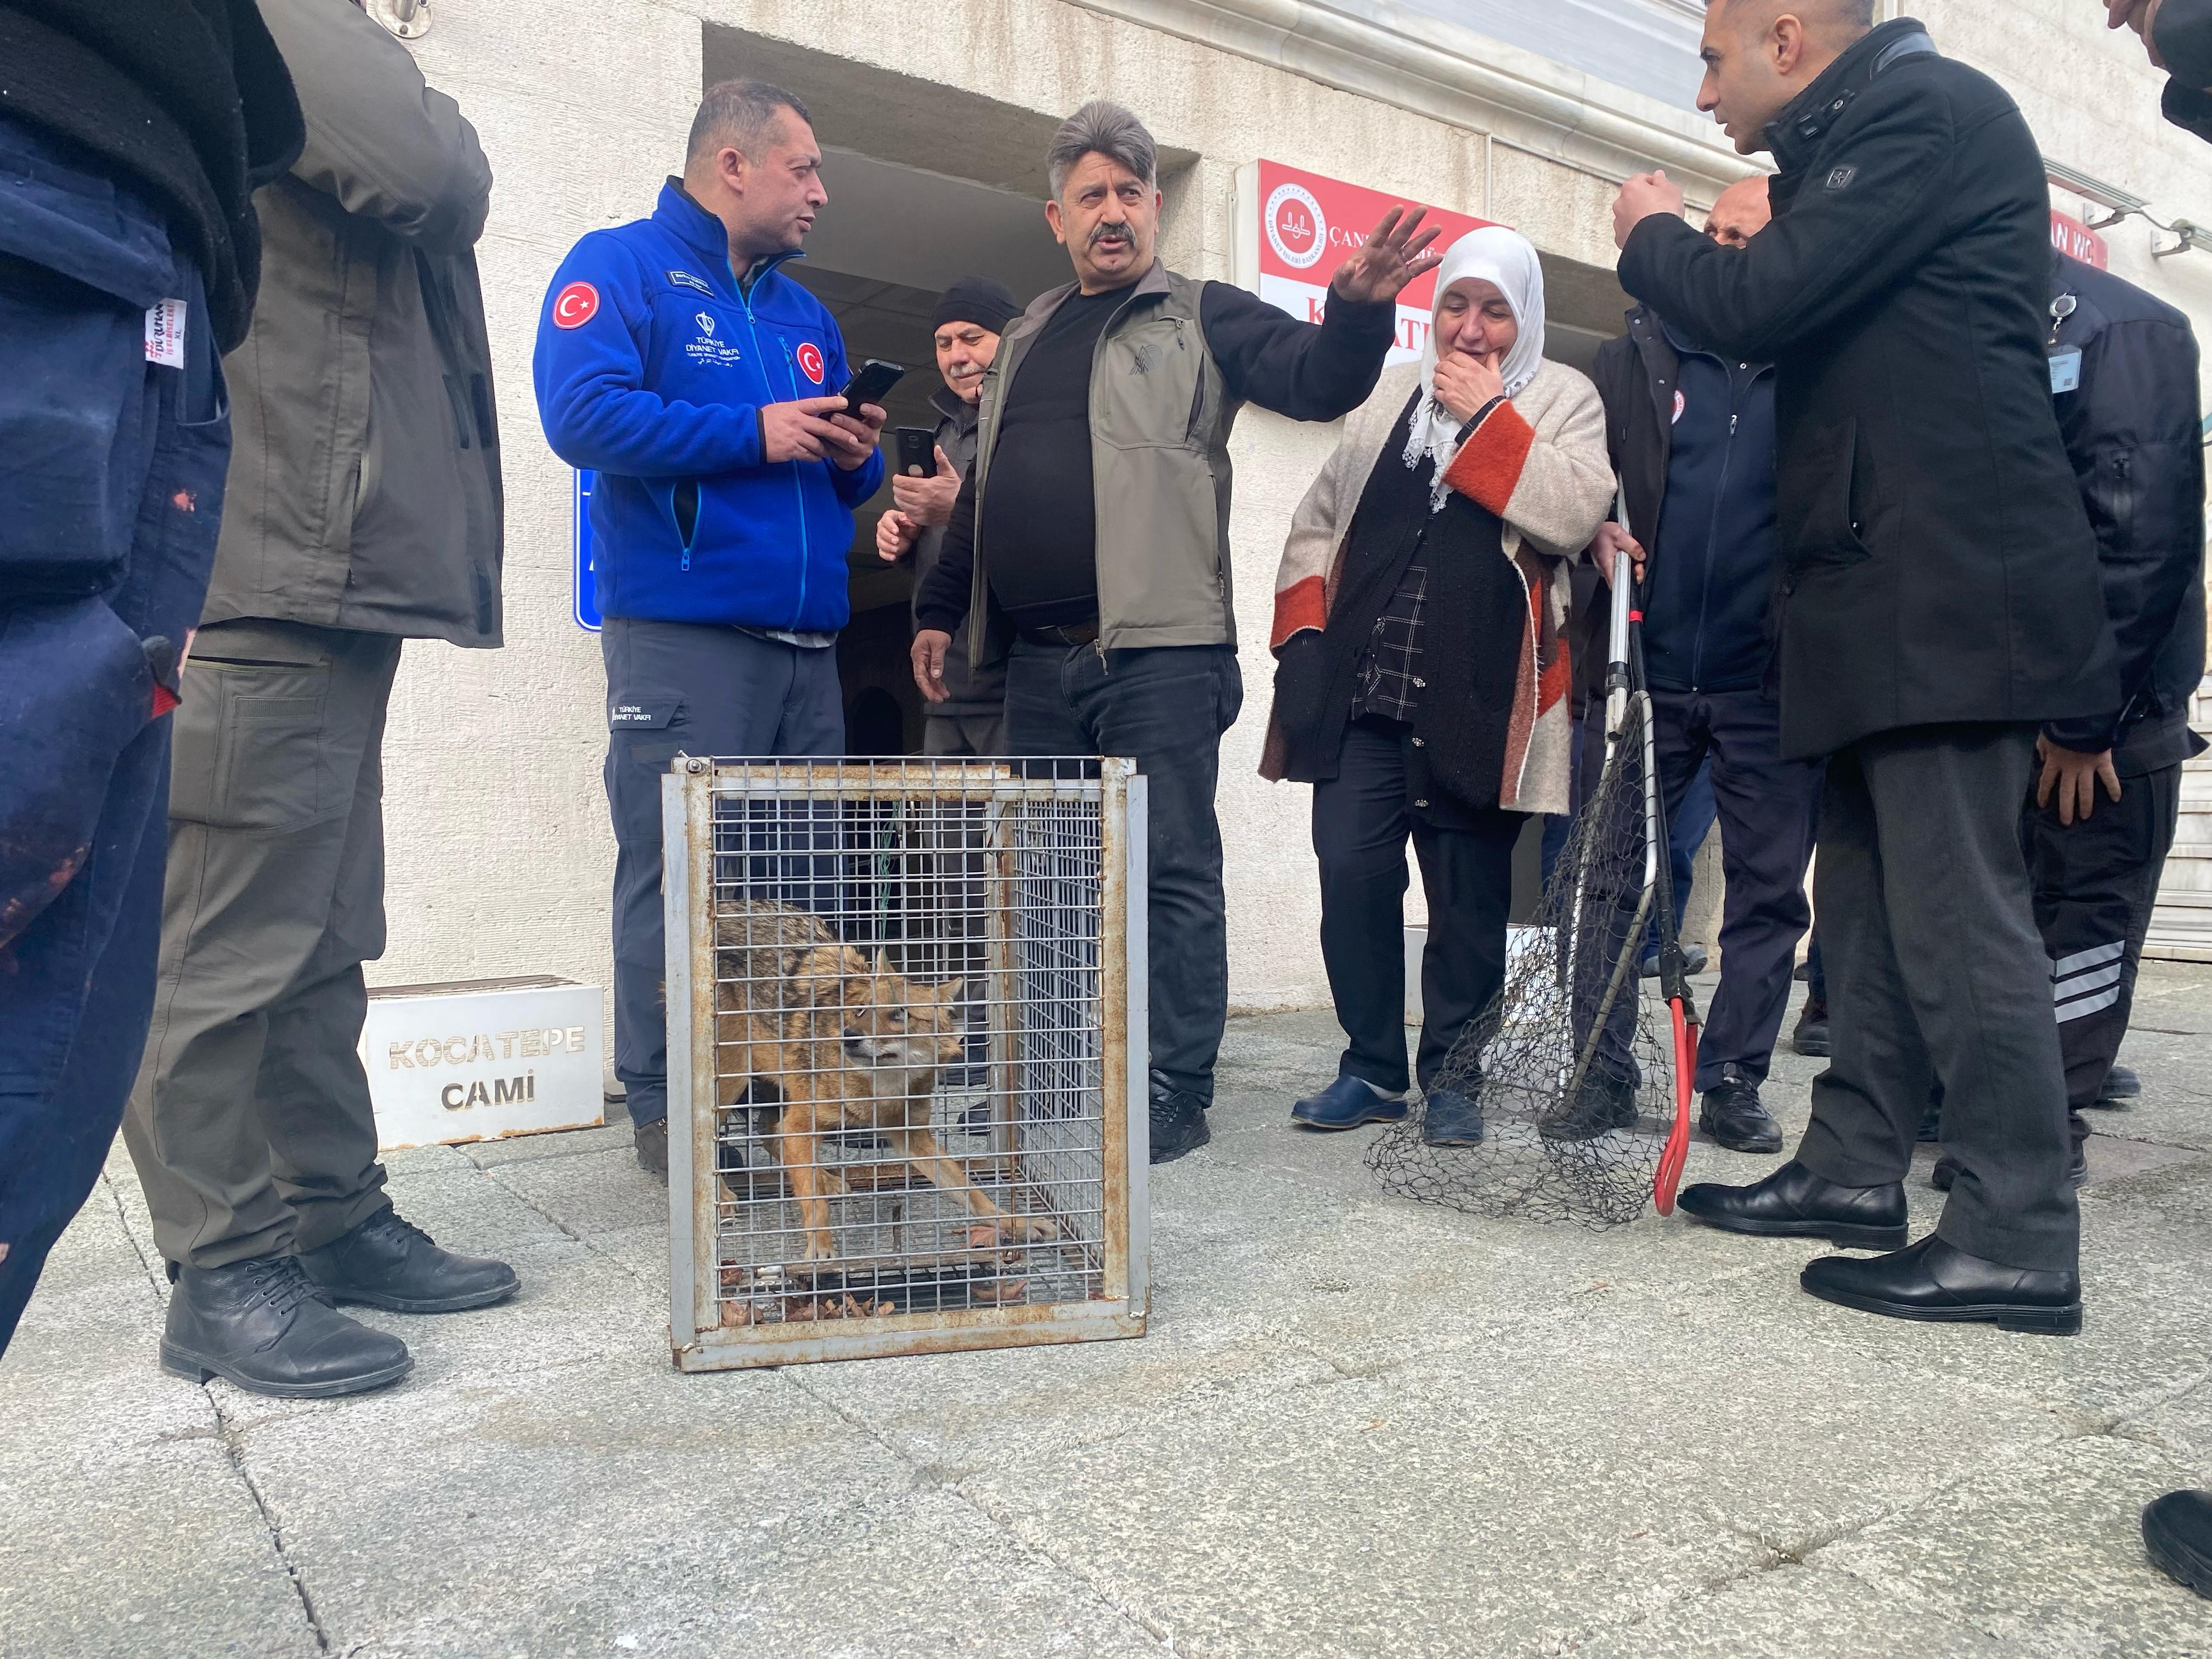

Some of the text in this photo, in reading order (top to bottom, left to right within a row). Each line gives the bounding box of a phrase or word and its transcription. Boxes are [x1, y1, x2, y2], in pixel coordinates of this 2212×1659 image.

[2073, 230, 2094, 264] WC
[174, 329, 181, 340] XL
[695, 336, 726, 348] TÜRKİYE
[686, 343, 716, 353] DİYANET
[390, 1026, 585, 1069] KOCATEPE
[441, 1068, 535, 1110] CAMİ
